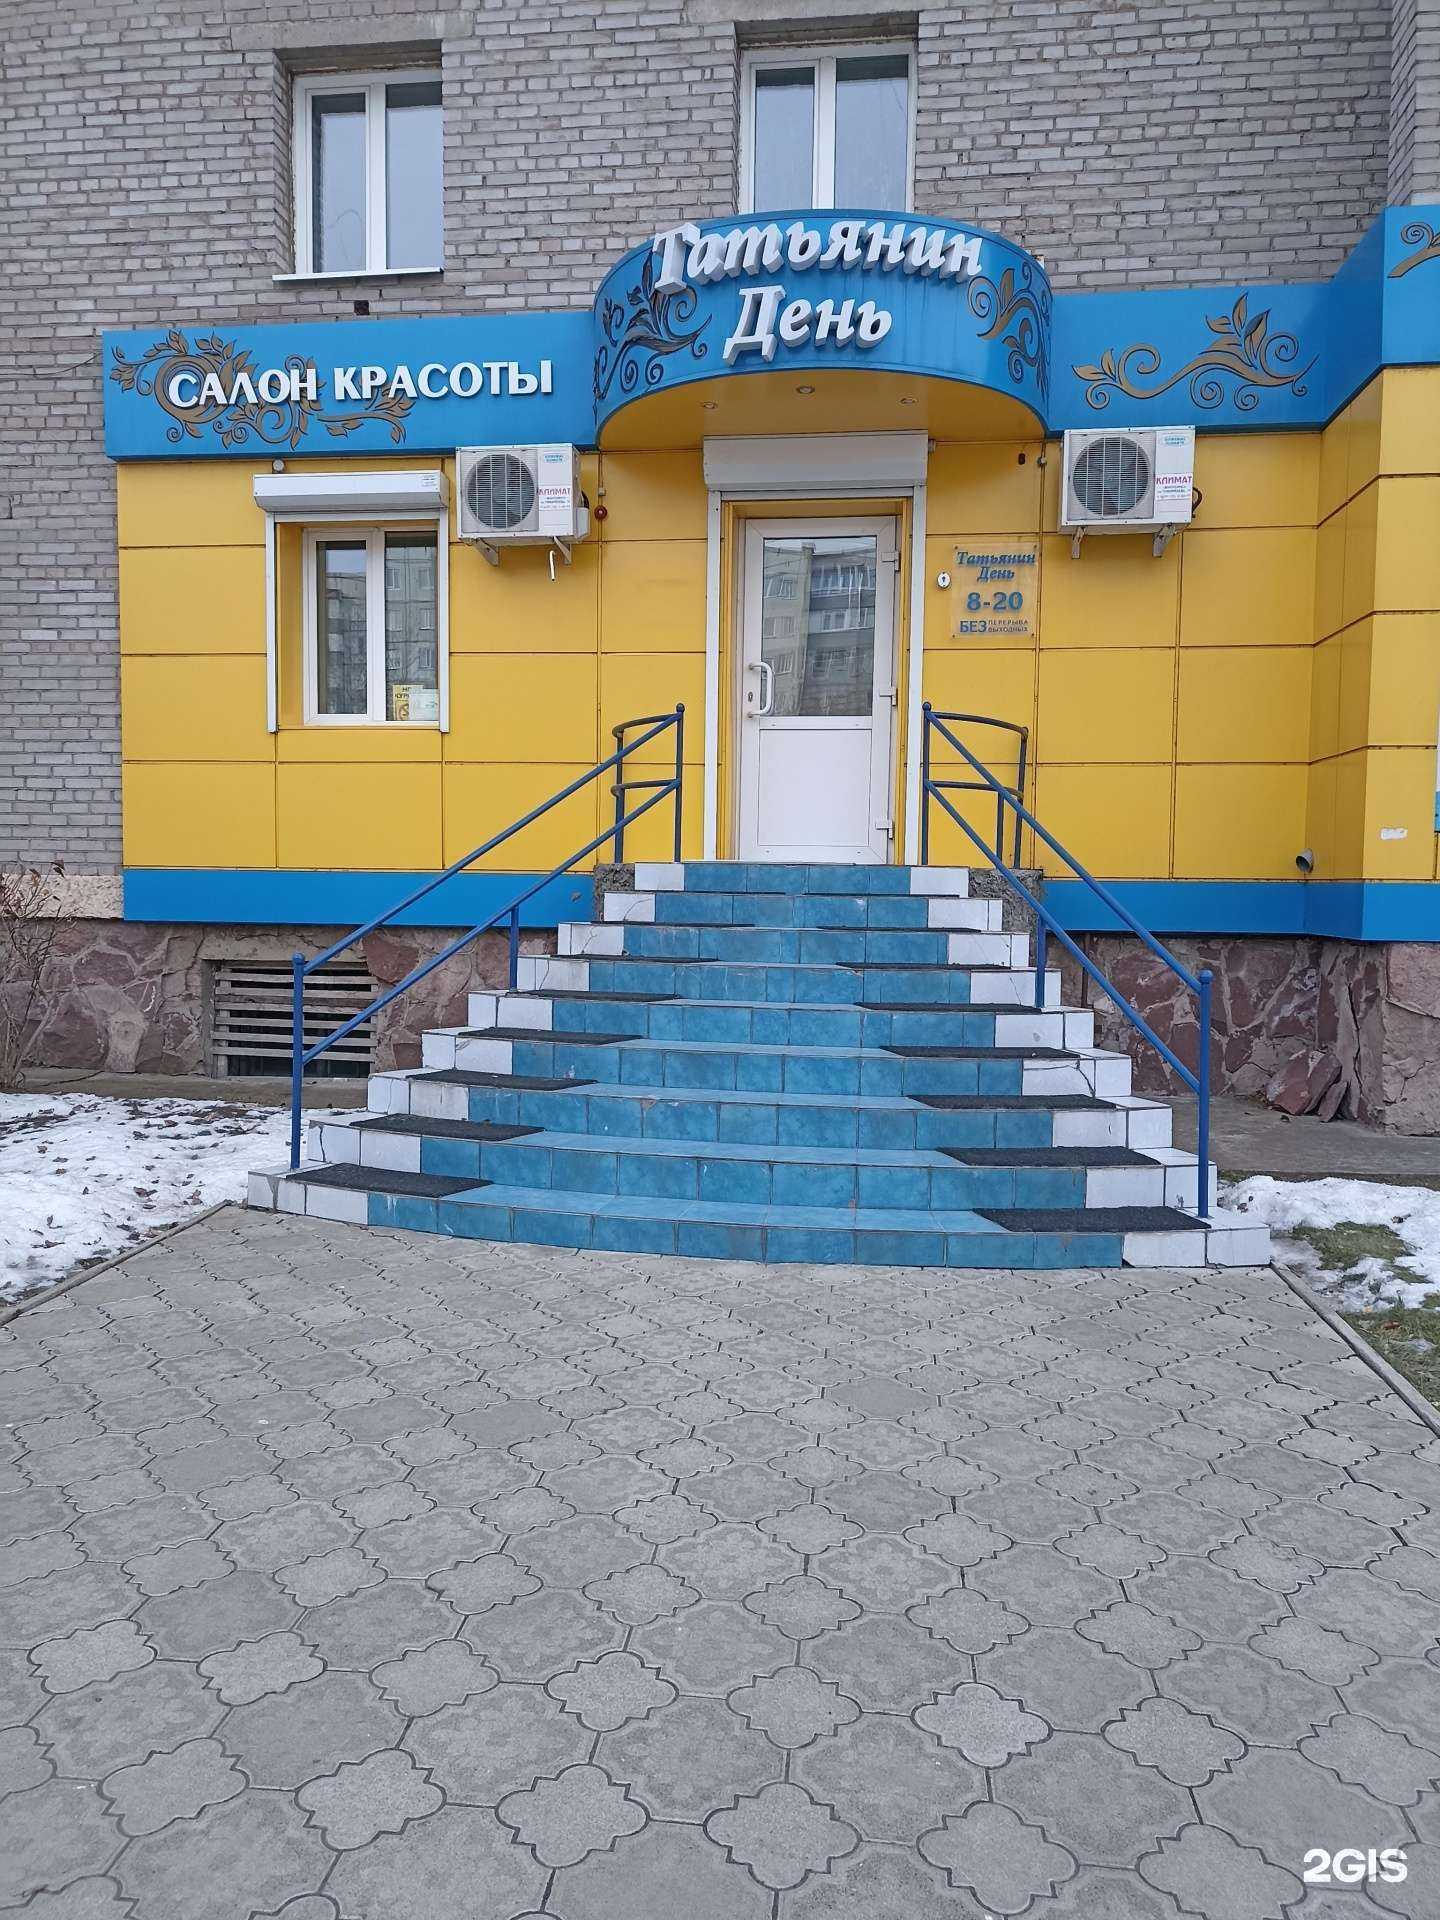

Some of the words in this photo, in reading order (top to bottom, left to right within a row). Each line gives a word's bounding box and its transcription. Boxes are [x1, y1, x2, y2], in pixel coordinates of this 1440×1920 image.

[653, 221, 983, 294] Татьянин
[722, 285, 893, 366] День
[168, 368, 317, 408] САЛОН
[334, 360, 553, 400] КРАСОТЫ
[1156, 475, 1193, 485] КЛИМАТ
[957, 551, 1036, 565] Татьянин
[977, 566, 1015, 582] День
[967, 591, 1023, 611] 8-20
[960, 620, 987, 632] БЕЗ
